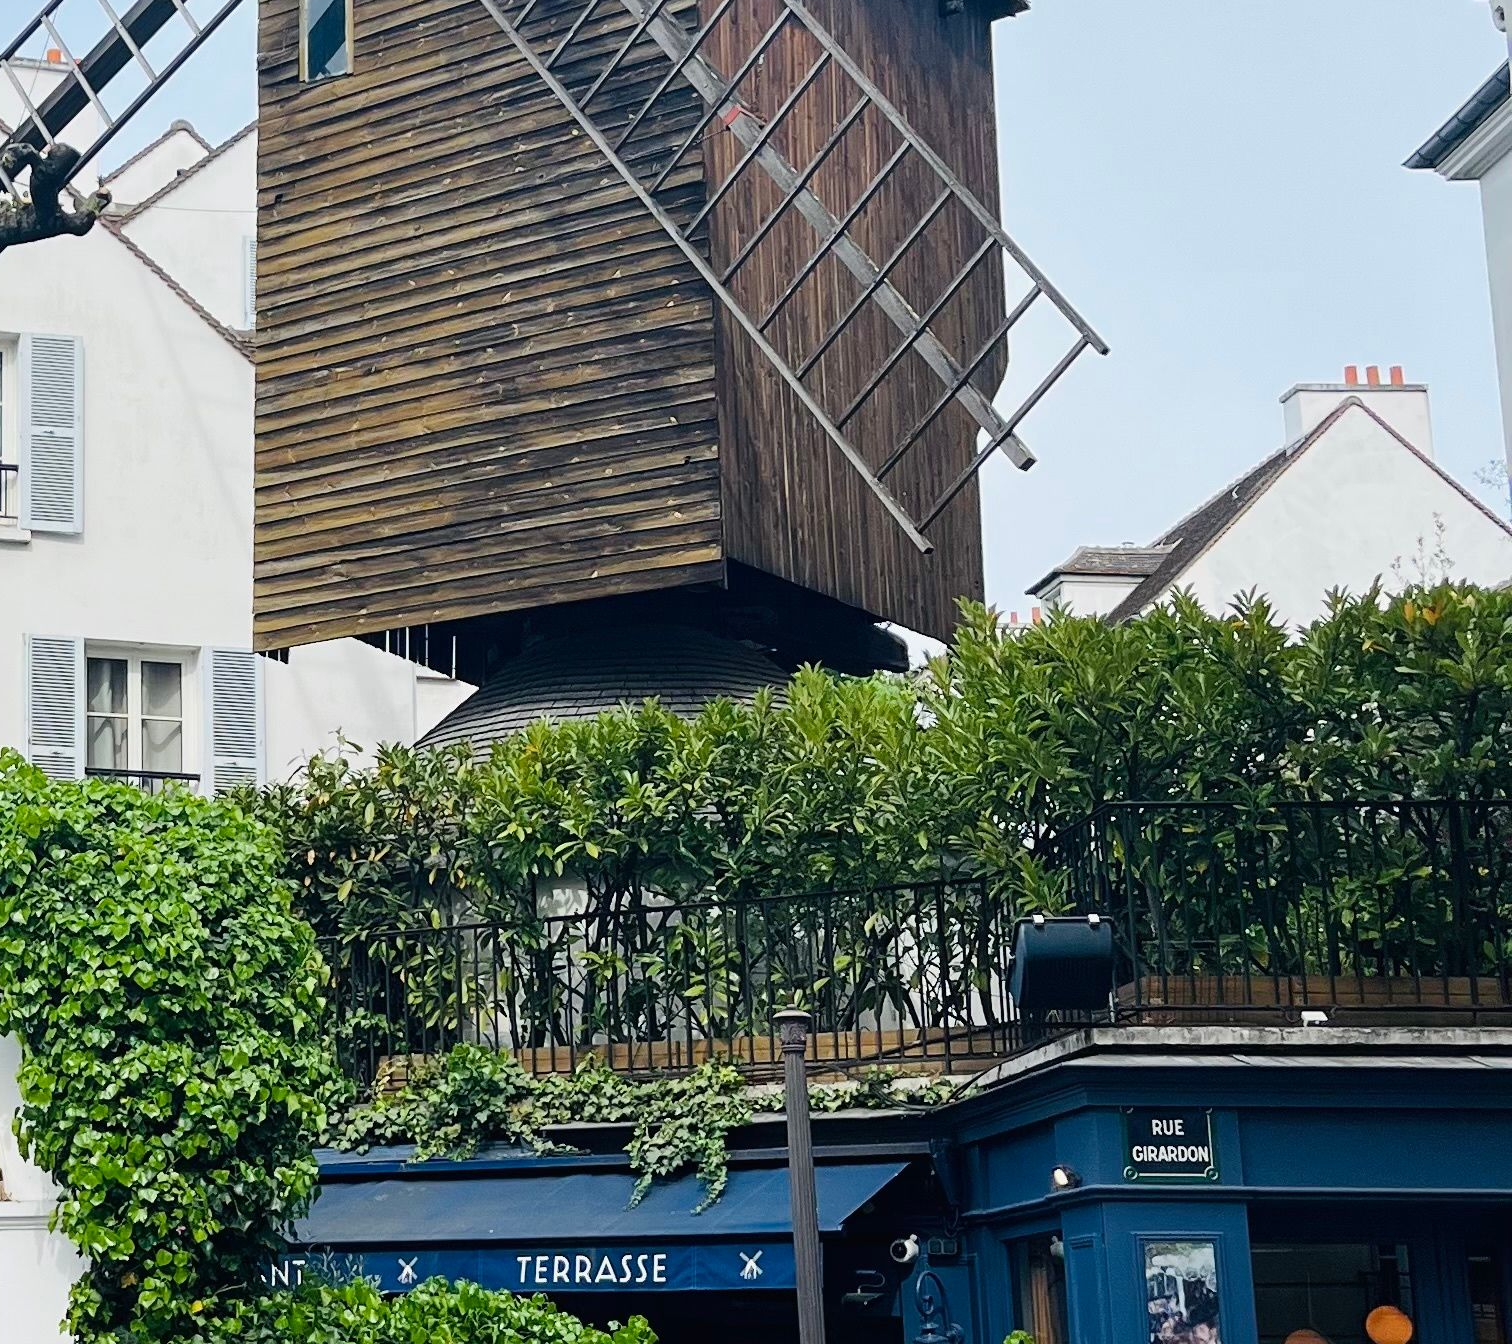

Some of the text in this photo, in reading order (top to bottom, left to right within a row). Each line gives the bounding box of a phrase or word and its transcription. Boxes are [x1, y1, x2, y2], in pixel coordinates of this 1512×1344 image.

[1151, 1119, 1185, 1136] RUE
[1132, 1145, 1209, 1162] GIRARDON
[261, 1253, 667, 1287] NT TERRASSE
